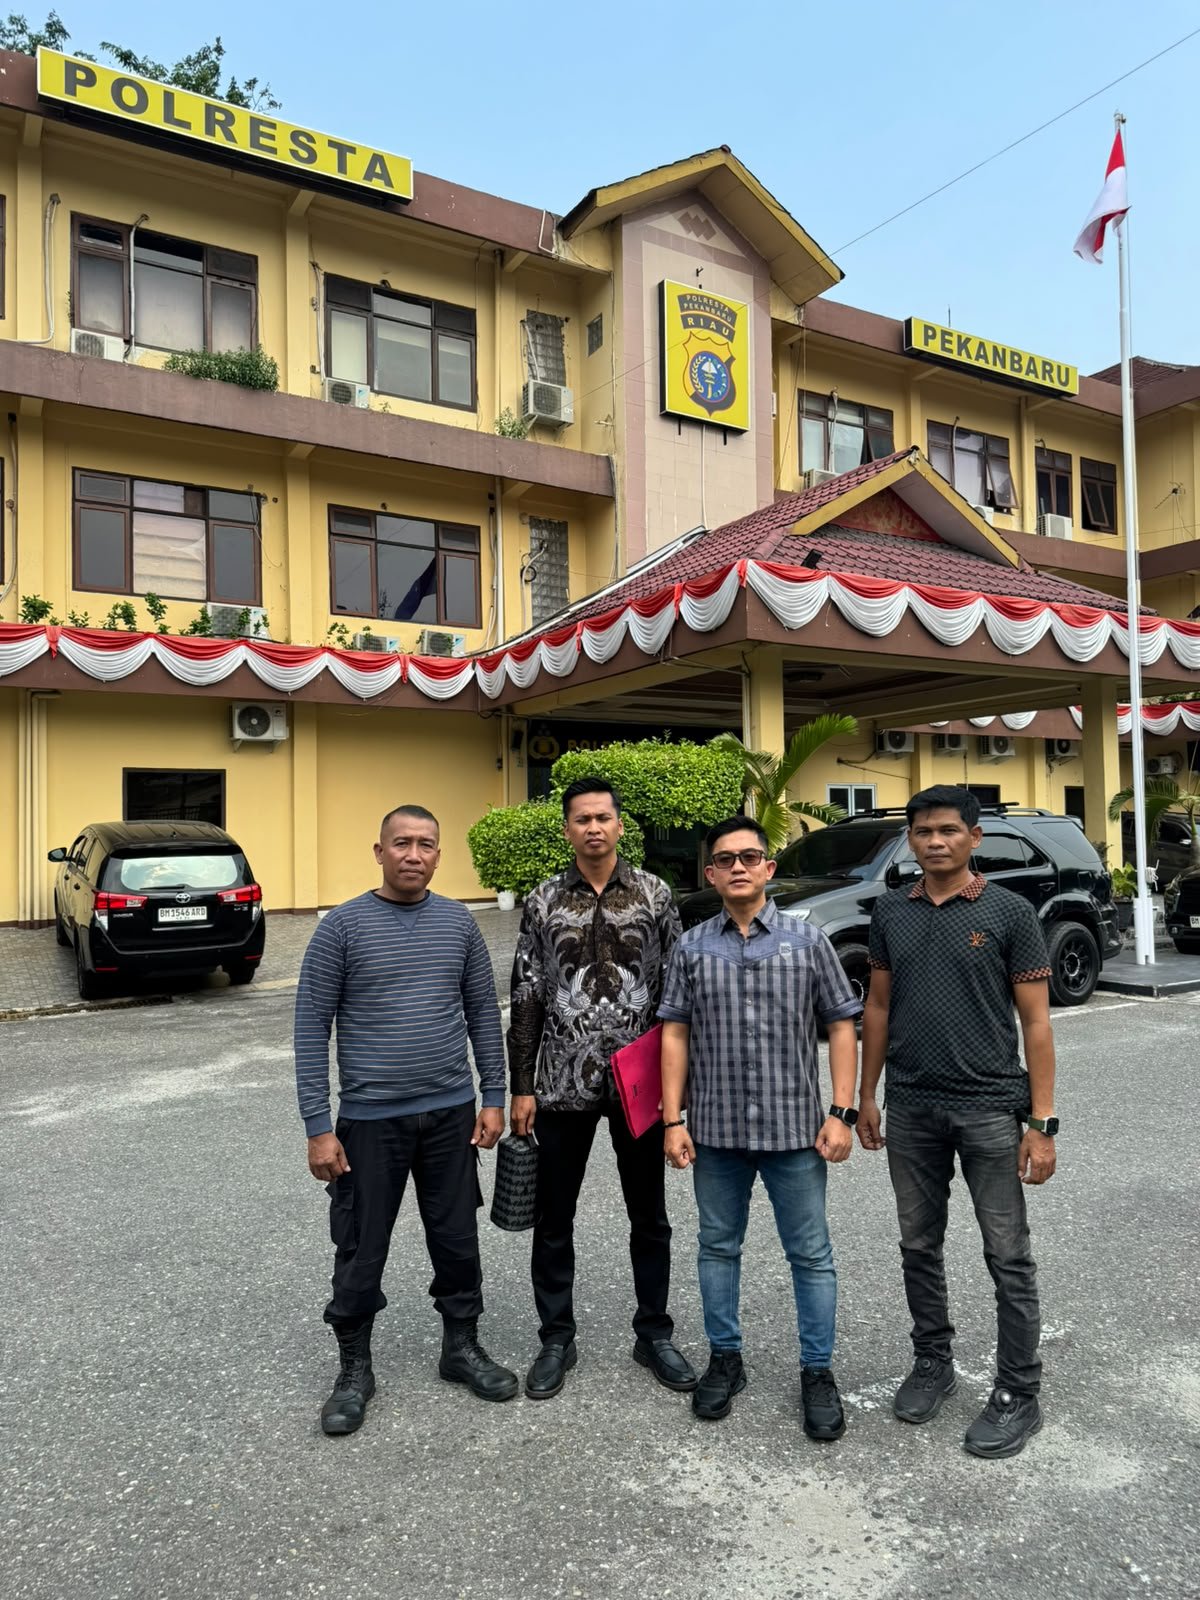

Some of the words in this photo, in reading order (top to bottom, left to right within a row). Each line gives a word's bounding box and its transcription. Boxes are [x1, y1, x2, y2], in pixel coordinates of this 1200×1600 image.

[64, 59, 395, 189] POLRESTA
[686, 295, 729, 312] POLRESTA
[684, 304, 732, 322] PEKANBARU
[687, 318, 729, 336] RIAU
[923, 323, 1070, 387] PEKANBARU
[160, 909, 170, 917] BM
[171, 908, 190, 917] 1546
